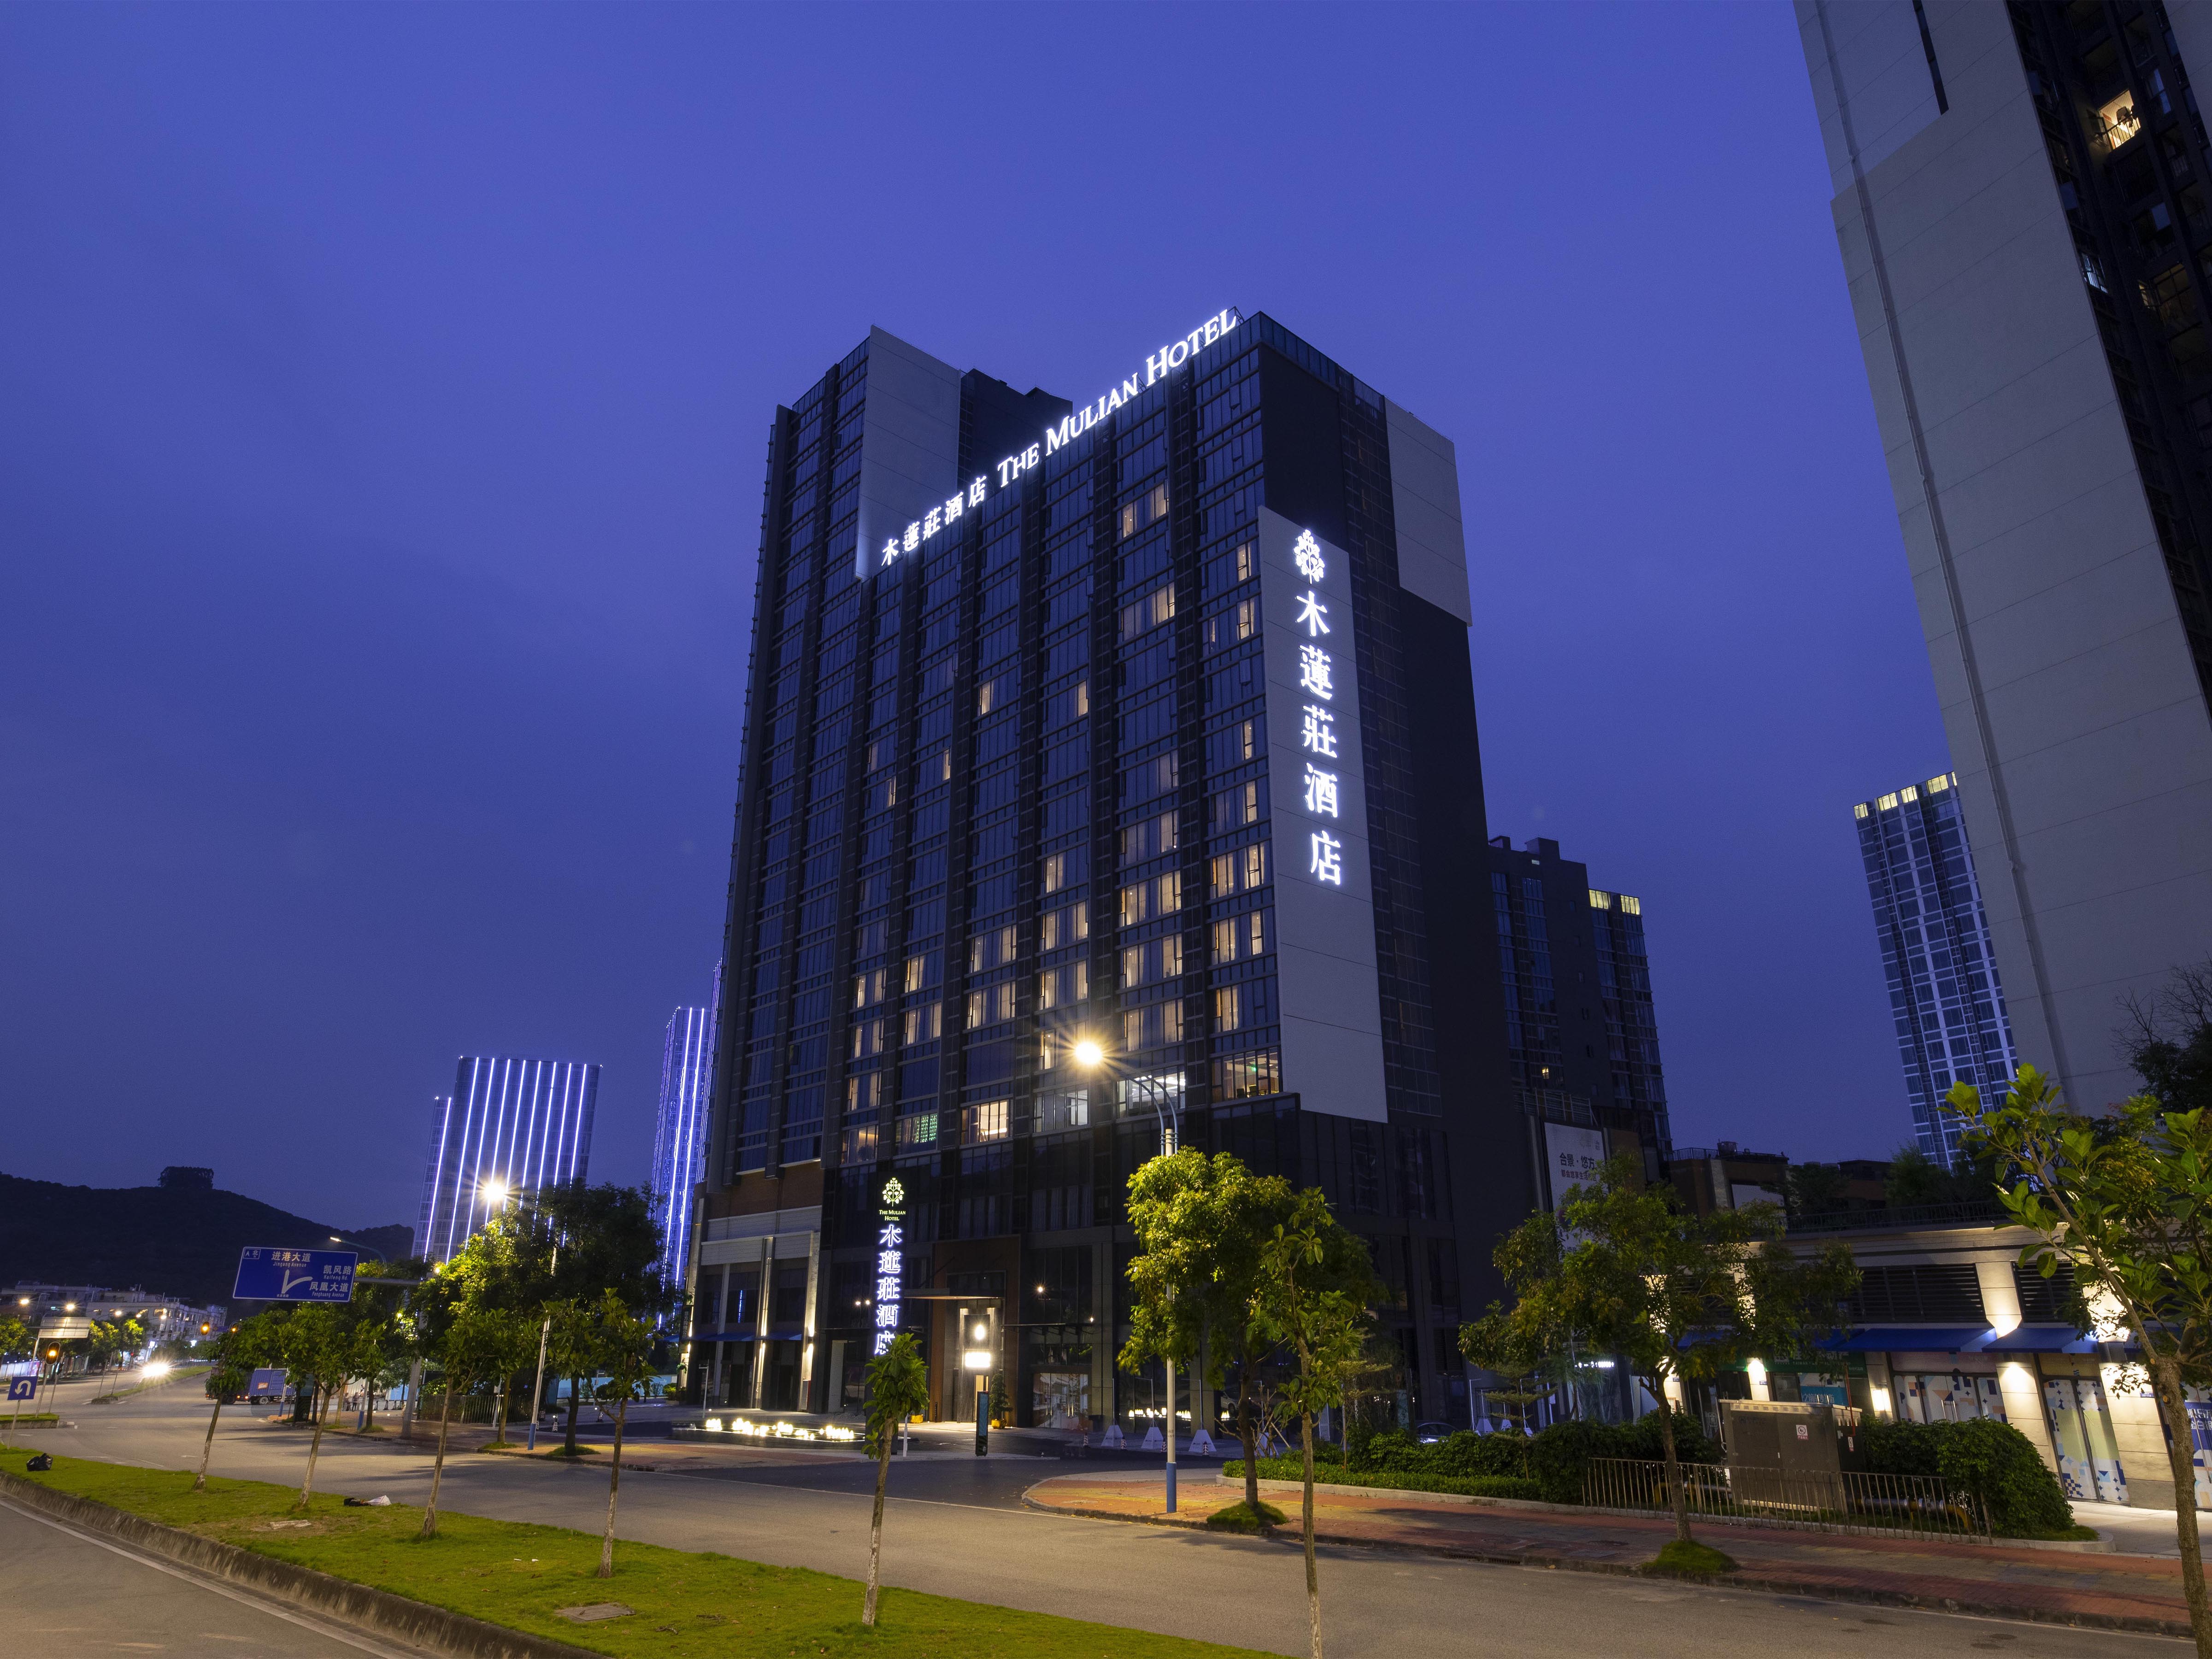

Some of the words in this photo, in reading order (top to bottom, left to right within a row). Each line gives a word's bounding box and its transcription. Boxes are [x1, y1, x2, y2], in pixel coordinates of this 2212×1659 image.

[881, 475, 987, 566] 木蓮莊酒店
[997, 442, 1040, 488] THE
[1046, 372, 1139, 456] MULIAN
[1146, 309, 1236, 387] HOTEL
[1295, 590, 1341, 886] 木蓮莊酒店
[271, 1251, 311, 1262] 进港大道
[323, 1265, 352, 1275] 凯风路
[309, 1282, 349, 1292] 凤凰大道
